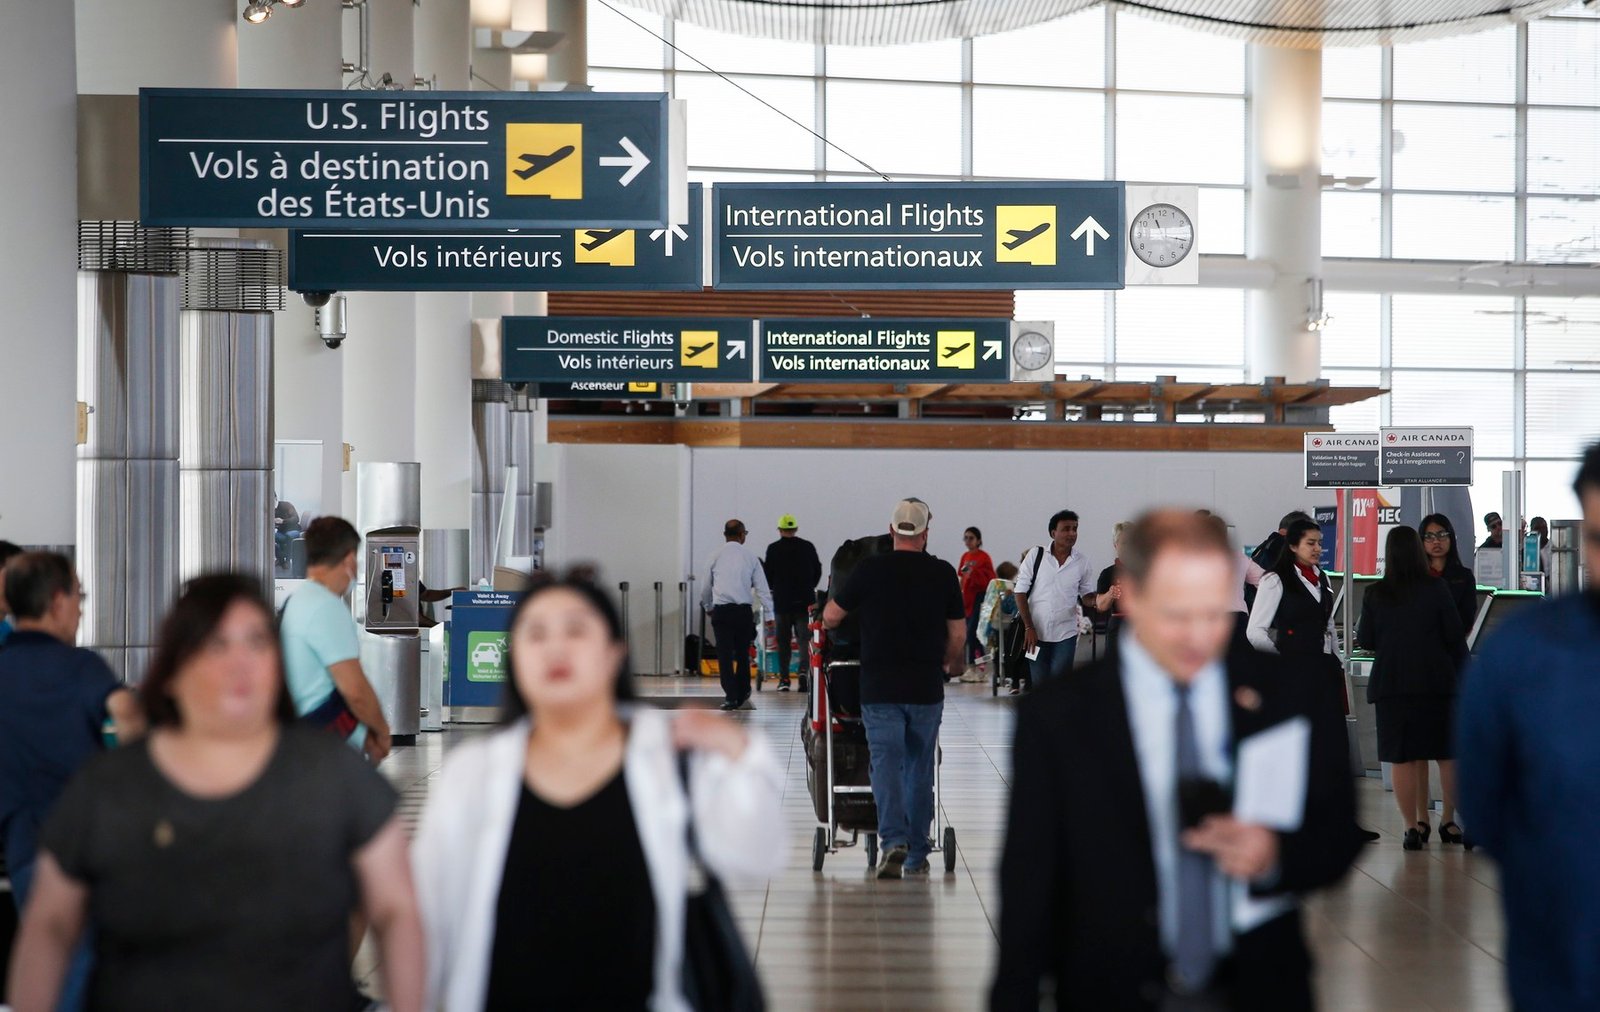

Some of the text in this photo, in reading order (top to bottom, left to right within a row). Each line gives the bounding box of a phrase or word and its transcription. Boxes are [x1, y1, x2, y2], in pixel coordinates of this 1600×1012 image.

[307, 101, 490, 138] U.S. Flights
[189, 150, 489, 181] Vols à destination
[257, 184, 490, 219] des États-Unis
[726, 202, 984, 233] International Flights
[1147, 212, 1155, 220] 11
[1158, 209, 1167, 217] 12
[373, 244, 563, 268] Vols intérieurs
[731, 244, 984, 268] Vols internationaux
[547, 329, 674, 349] Domestic Flights
[767, 329, 931, 350] International Flights
[558, 354, 674, 370] Vols intérieurs
[771, 354, 930, 371] Vols internationaux
[570, 381, 625, 391] Ascenseur
[1401, 434, 1465, 442] AIR CANADA
[1353, 498, 1366, 517] nx
[1377, 508, 1400, 523] HEC
